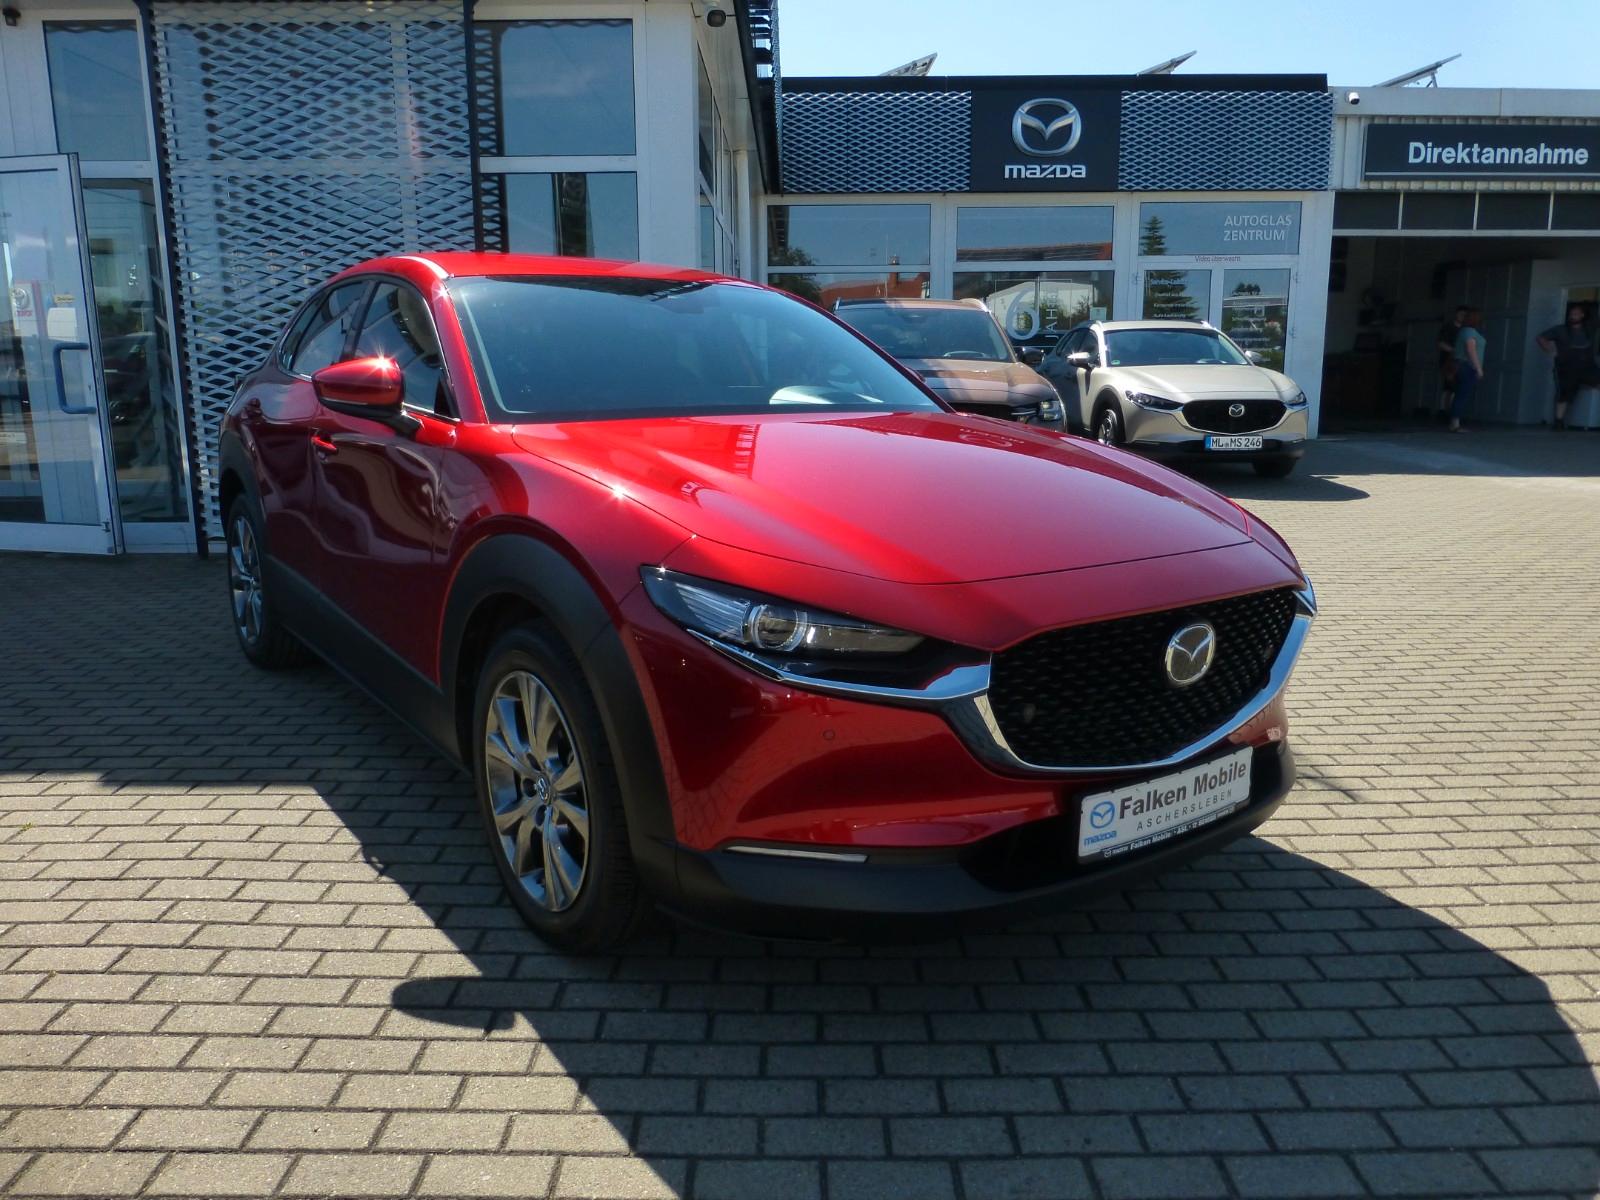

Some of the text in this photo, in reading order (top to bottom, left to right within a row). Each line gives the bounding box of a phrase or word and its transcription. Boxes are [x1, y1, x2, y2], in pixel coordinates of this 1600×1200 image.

[1408, 141, 1589, 165] Direktannahme
[1224, 215, 1292, 227] AUTOGLAS
[1223, 230, 1285, 241] ZENTRUM
[1211, 438, 1261, 448] ML MS 246
[1119, 785, 1187, 819] Falken
[1193, 761, 1247, 795] Mobile
[1136, 788, 1233, 831] ASCHERSLEBEN
